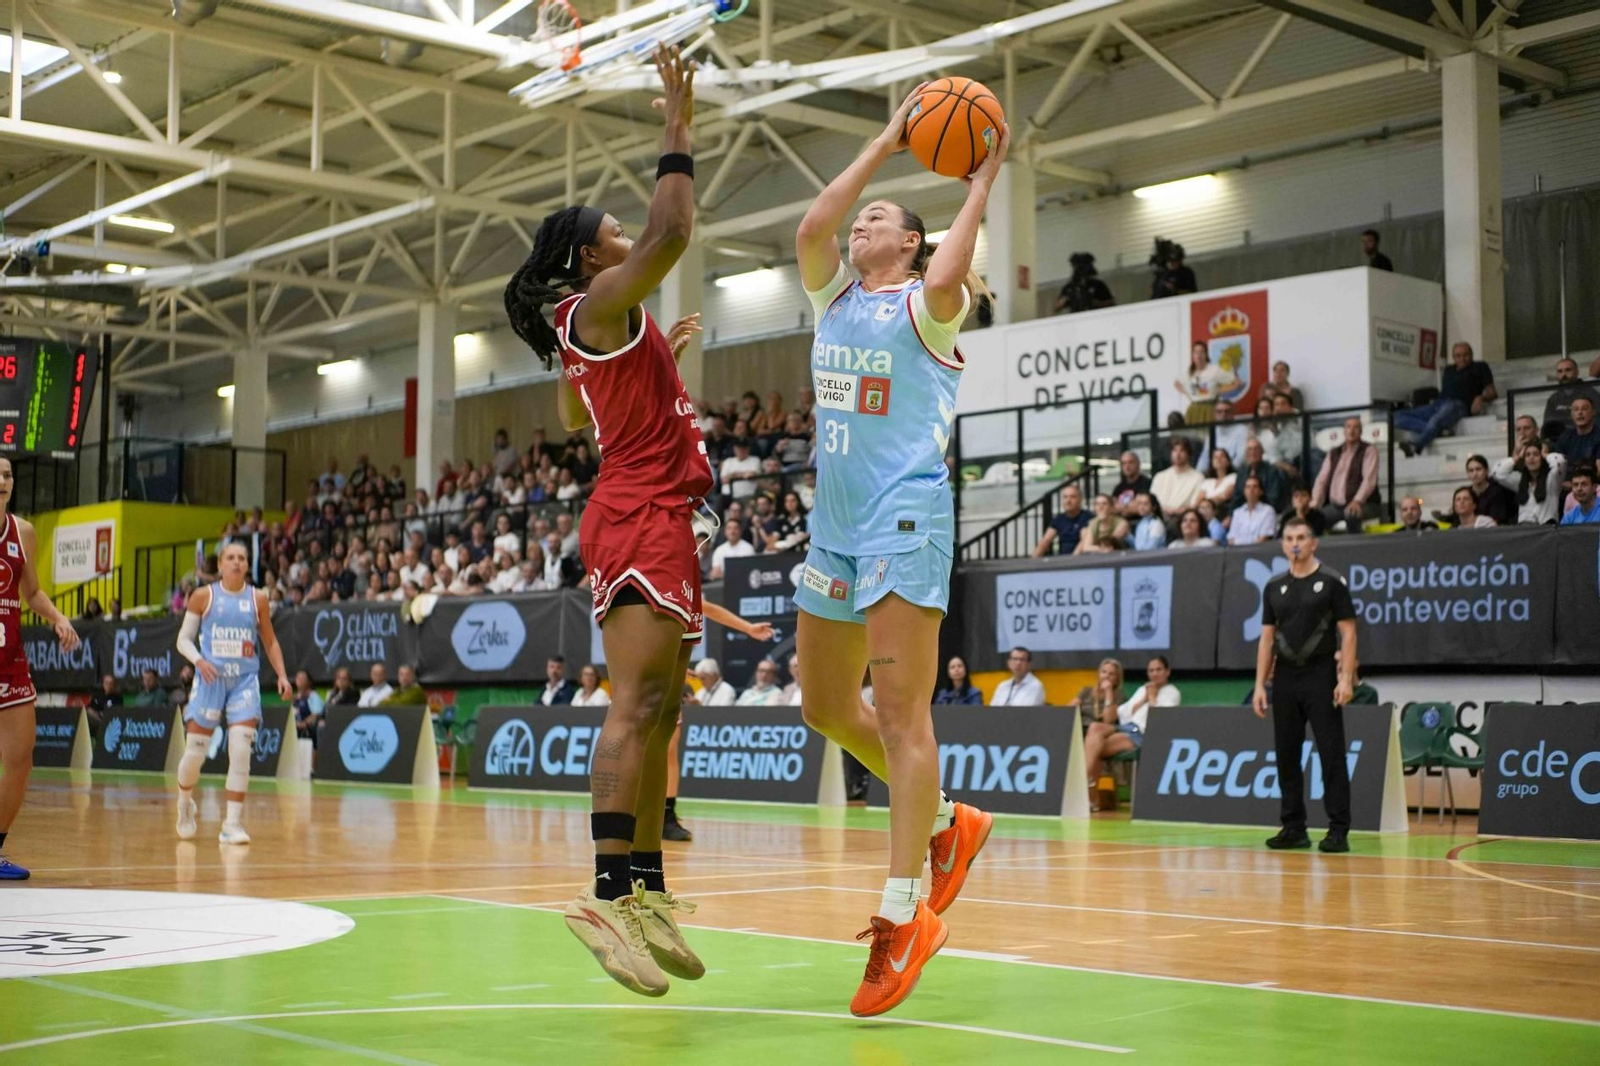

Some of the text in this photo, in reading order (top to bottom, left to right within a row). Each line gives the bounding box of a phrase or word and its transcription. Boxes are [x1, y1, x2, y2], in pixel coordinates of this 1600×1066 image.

[812, 332, 893, 374] femxa
[1018, 333, 1165, 379] CONCELLO
[822, 389, 845, 402] VIGO
[824, 419, 850, 456] 31
[1350, 553, 1530, 599] Deputación
[1004, 586, 1105, 609] CONCELLO
[346, 608, 398, 637] CLÍNICA
[1013, 612, 1092, 633] DE VIGO
[345, 638, 386, 661] CELTA
[130, 650, 171, 678] travel
[686, 725, 808, 749] BALONCESTO
[681, 751, 803, 782] FEMENINO
[938, 744, 1050, 794] mxa
[1497, 783, 1539, 799] grupo
